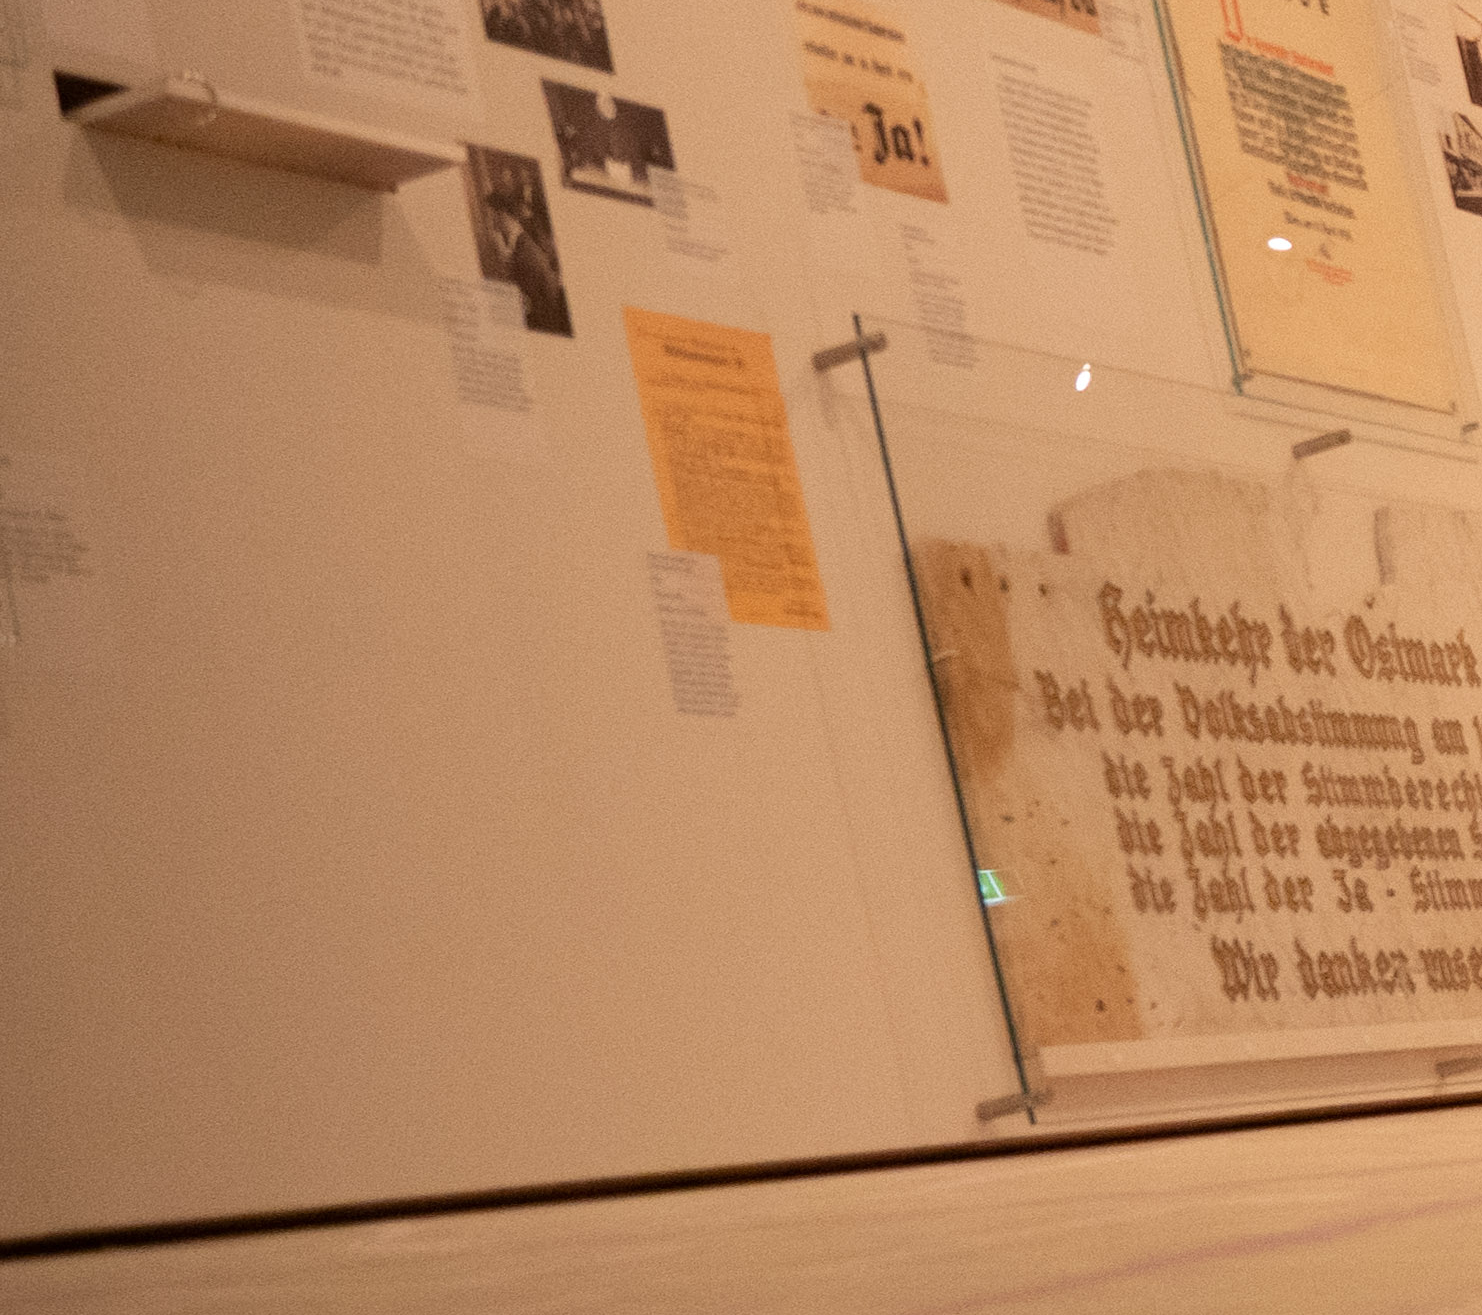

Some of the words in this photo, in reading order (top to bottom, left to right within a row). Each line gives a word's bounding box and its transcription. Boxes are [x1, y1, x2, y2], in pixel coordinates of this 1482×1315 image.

[1277, 602, 1337, 677] der
[1034, 668, 1100, 732] Bei
[1105, 674, 1165, 738] der
[1431, 717, 1470, 756] am
[1102, 750, 1151, 802] die
[1236, 753, 1288, 806] der
[1113, 805, 1164, 857] die
[1248, 810, 1300, 858] der
[1127, 862, 1177, 915] die
[1262, 865, 1314, 913] der
[1330, 868, 1374, 913] Ja
[1210, 934, 1280, 1003] Wir
